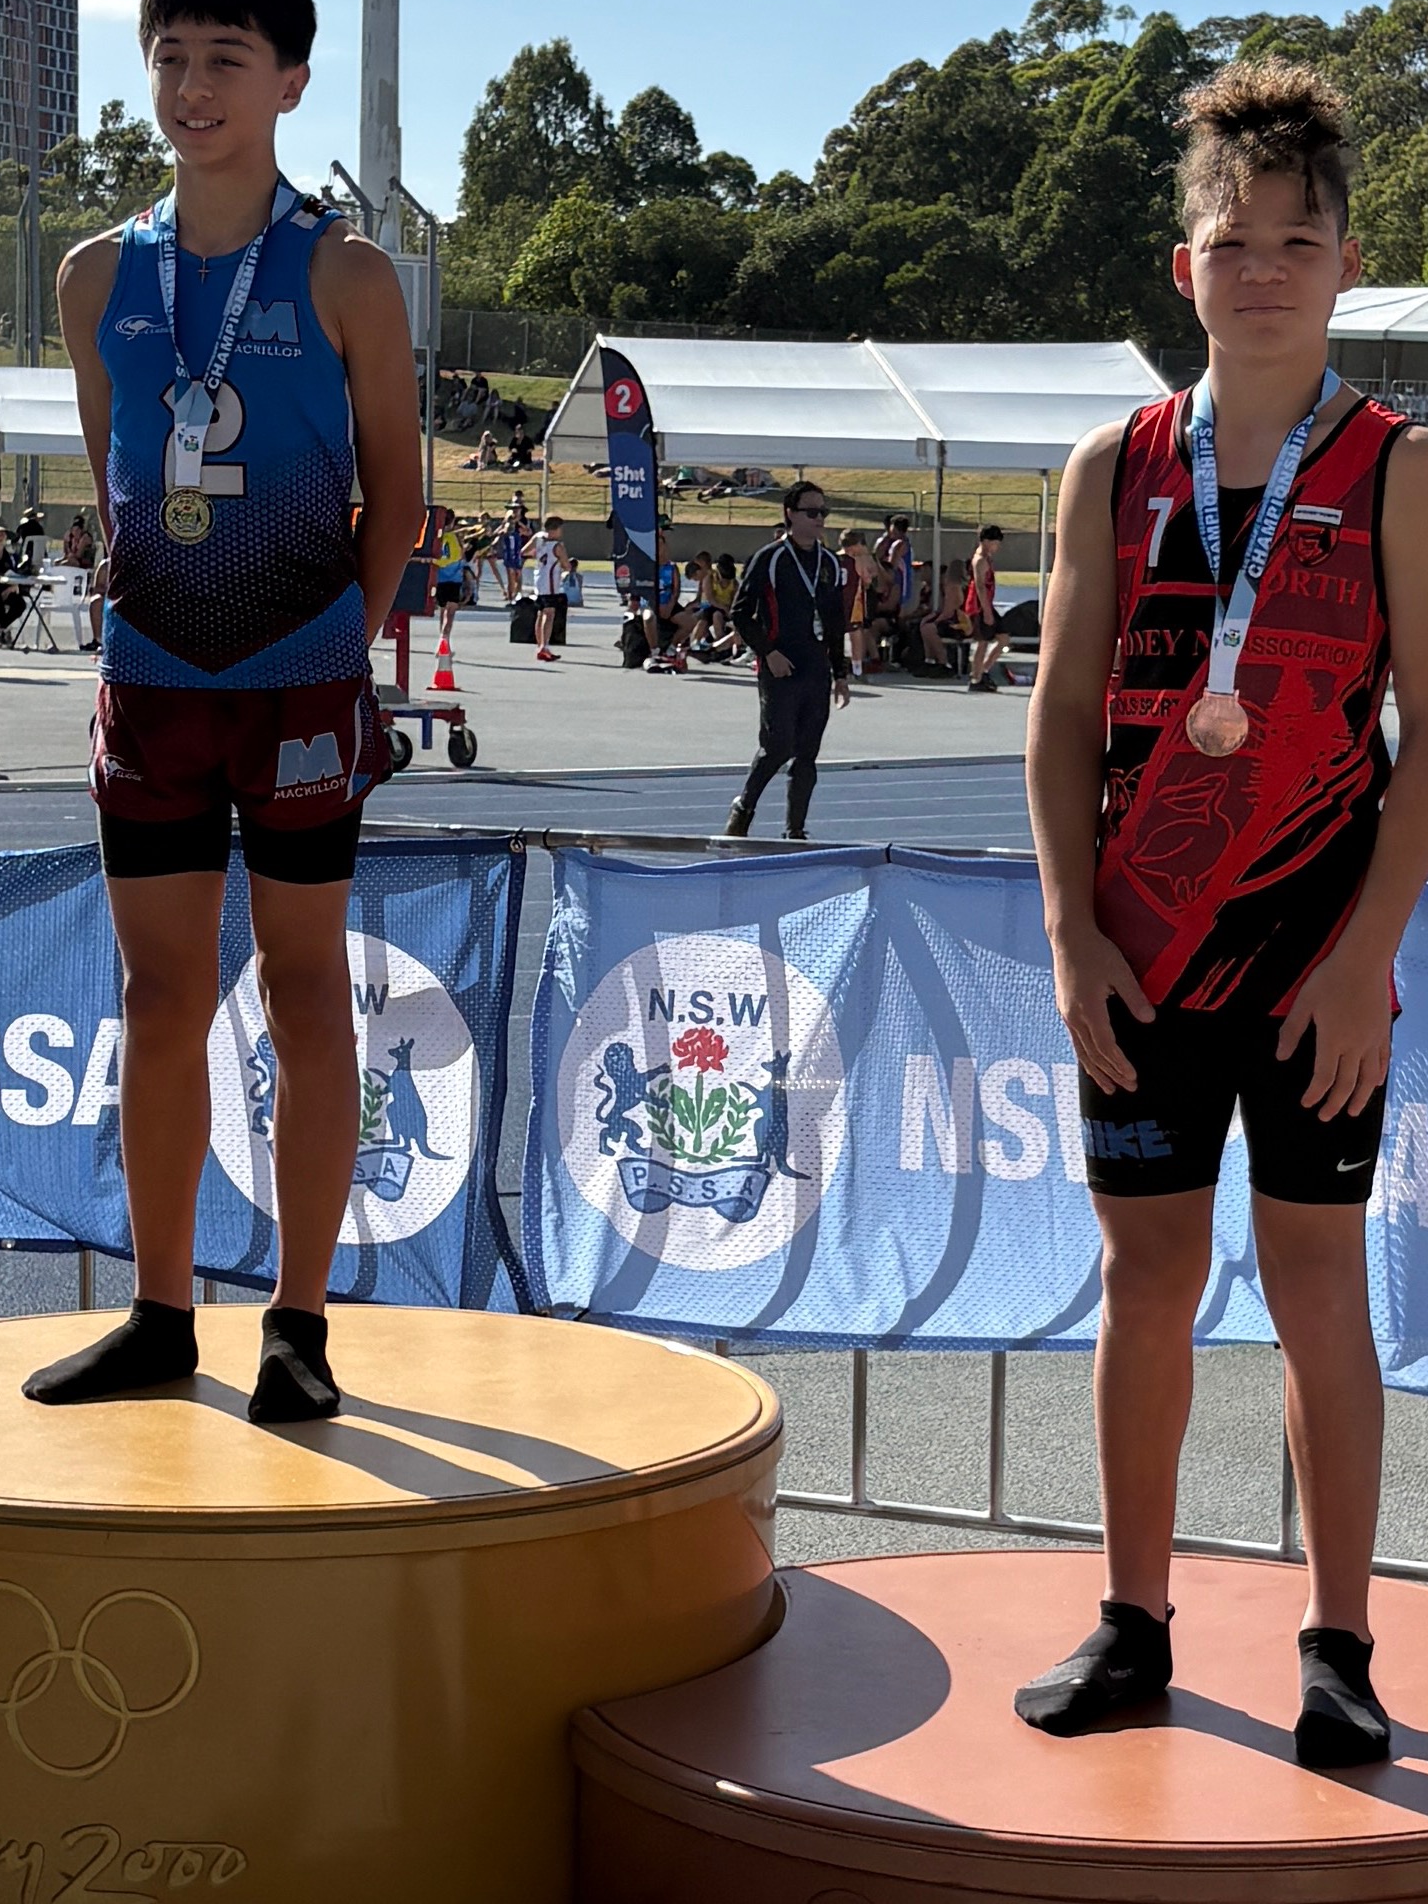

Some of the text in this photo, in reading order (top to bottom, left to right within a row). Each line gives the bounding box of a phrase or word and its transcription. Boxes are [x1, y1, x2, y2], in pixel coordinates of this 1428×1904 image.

[207, 235, 264, 390] CHAMPIONSHIPS
[234, 345, 302, 358] ACKILLOP
[616, 385, 632, 413] 2
[1247, 414, 1315, 580] CHAMPIONSHIPS
[1147, 497, 1174, 567] 7
[274, 776, 347, 800] MACKILLOP
